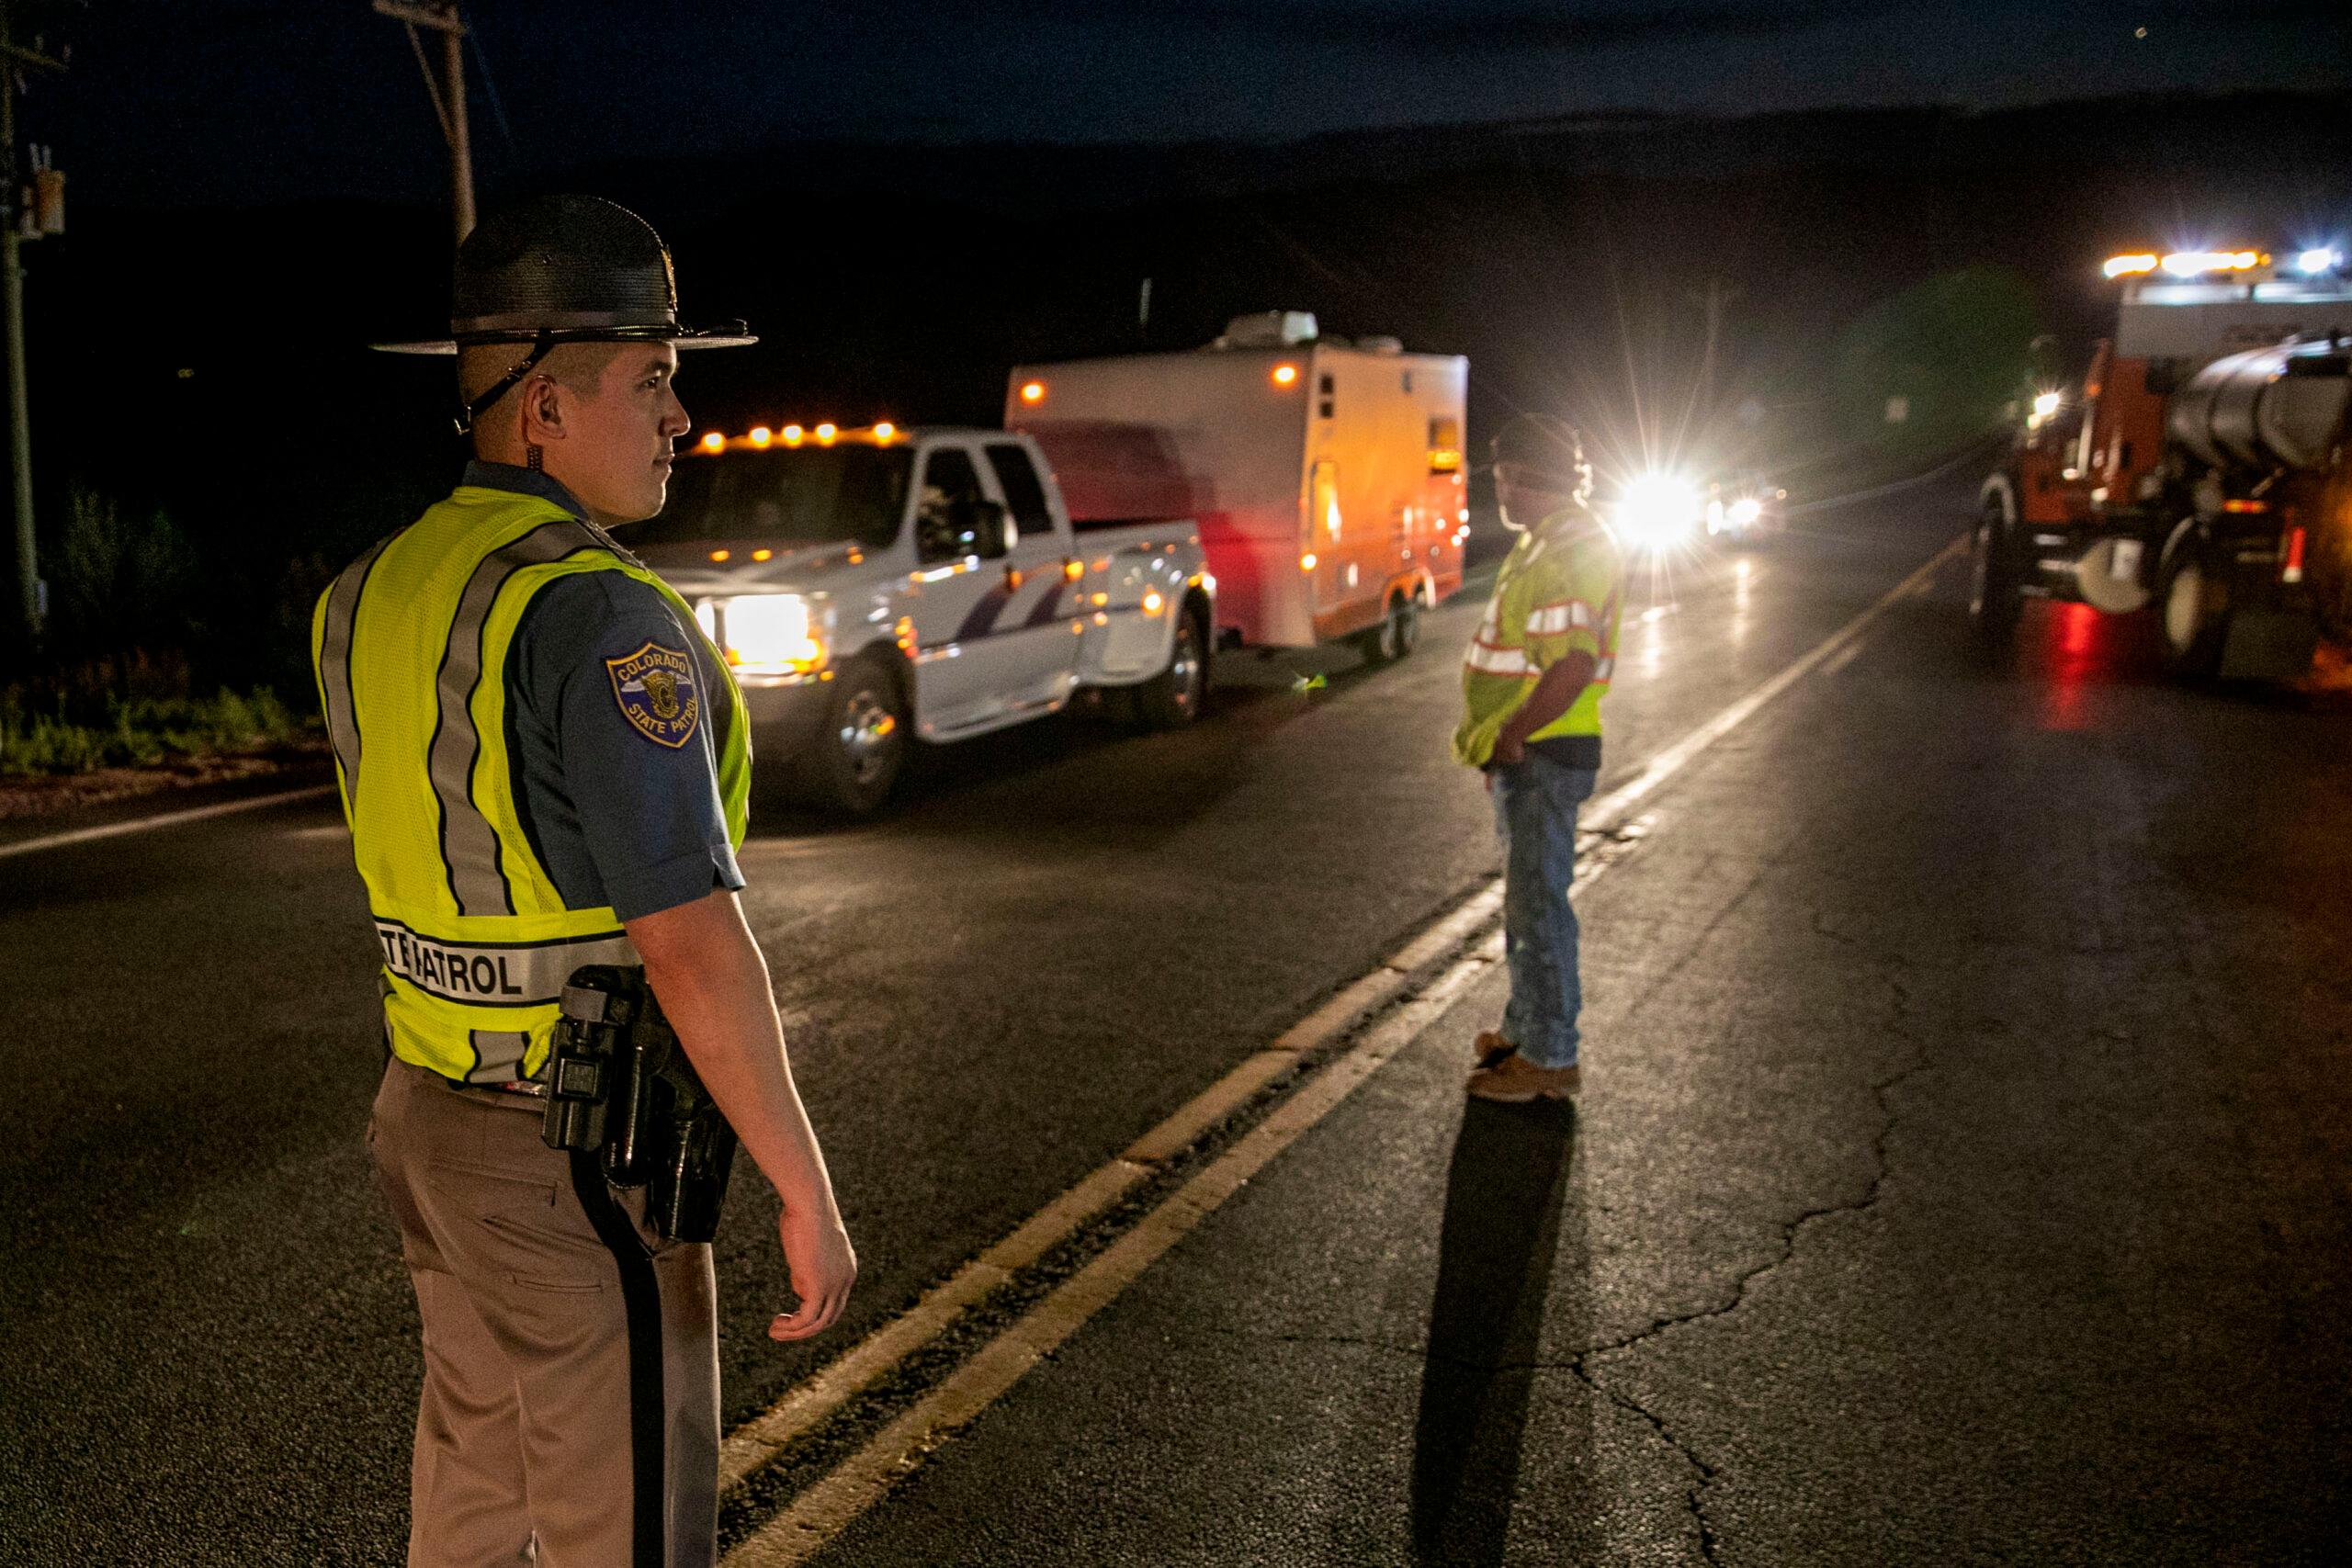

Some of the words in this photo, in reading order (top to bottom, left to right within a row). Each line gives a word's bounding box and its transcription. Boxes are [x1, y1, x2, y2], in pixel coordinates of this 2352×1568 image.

[617, 653, 686, 682] COLORADO
[628, 703, 666, 734] STATE
[671, 697, 696, 733] PATROL
[379, 930, 411, 968] TE
